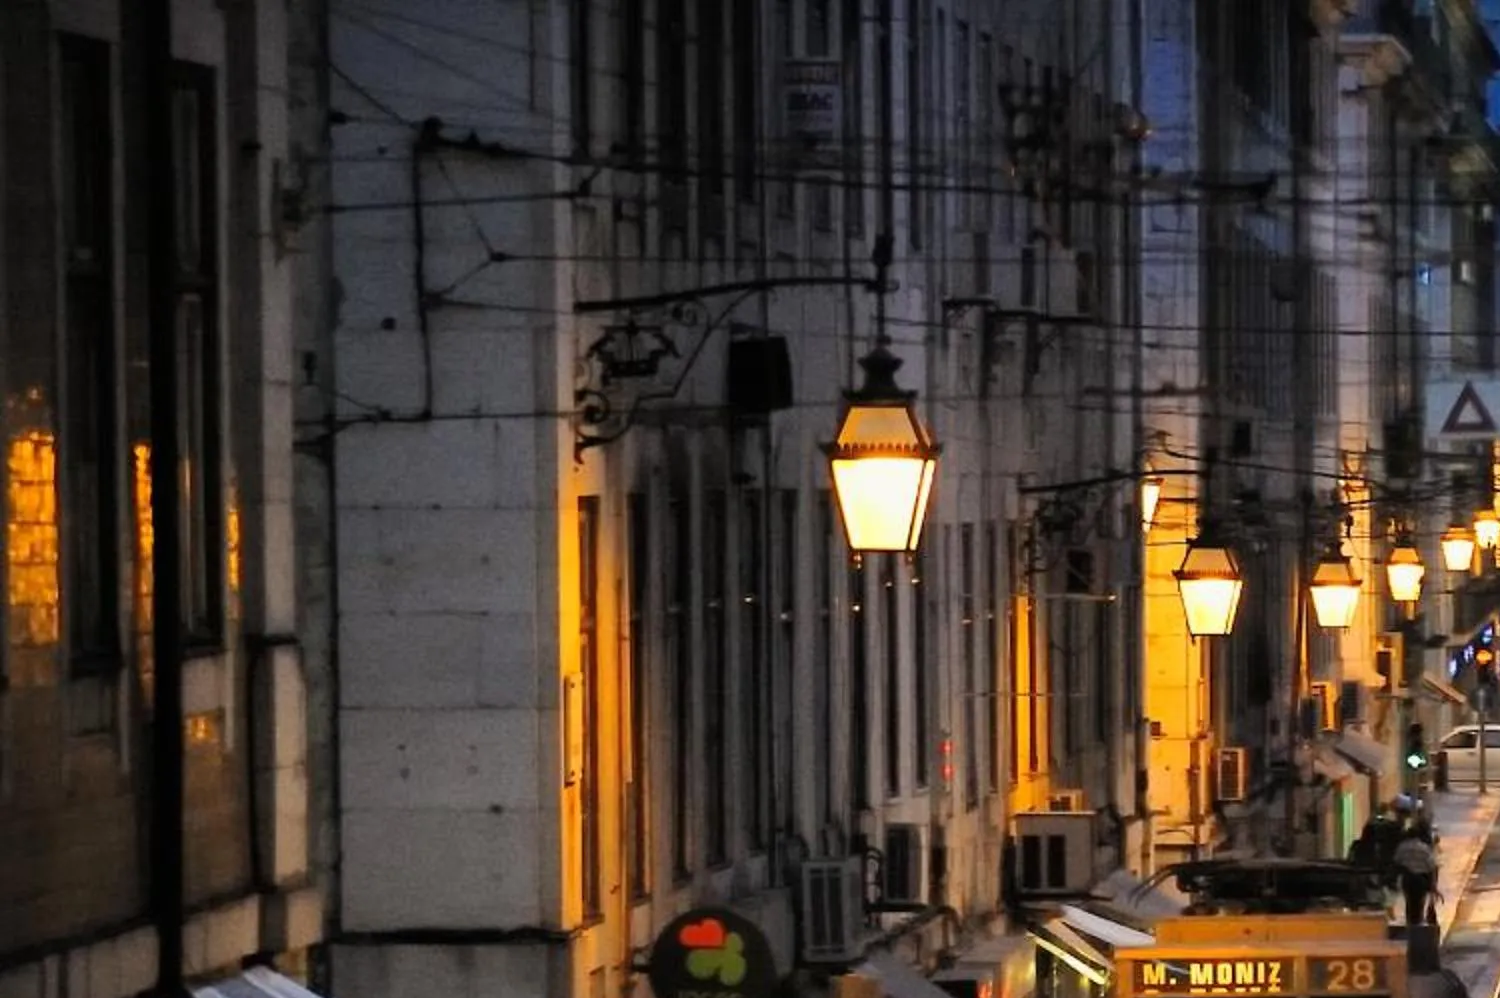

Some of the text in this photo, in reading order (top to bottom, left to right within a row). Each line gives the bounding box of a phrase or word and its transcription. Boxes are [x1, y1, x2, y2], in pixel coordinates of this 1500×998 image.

[1142, 962, 1281, 986] M. MONIZ
[1326, 959, 1375, 991] 28
